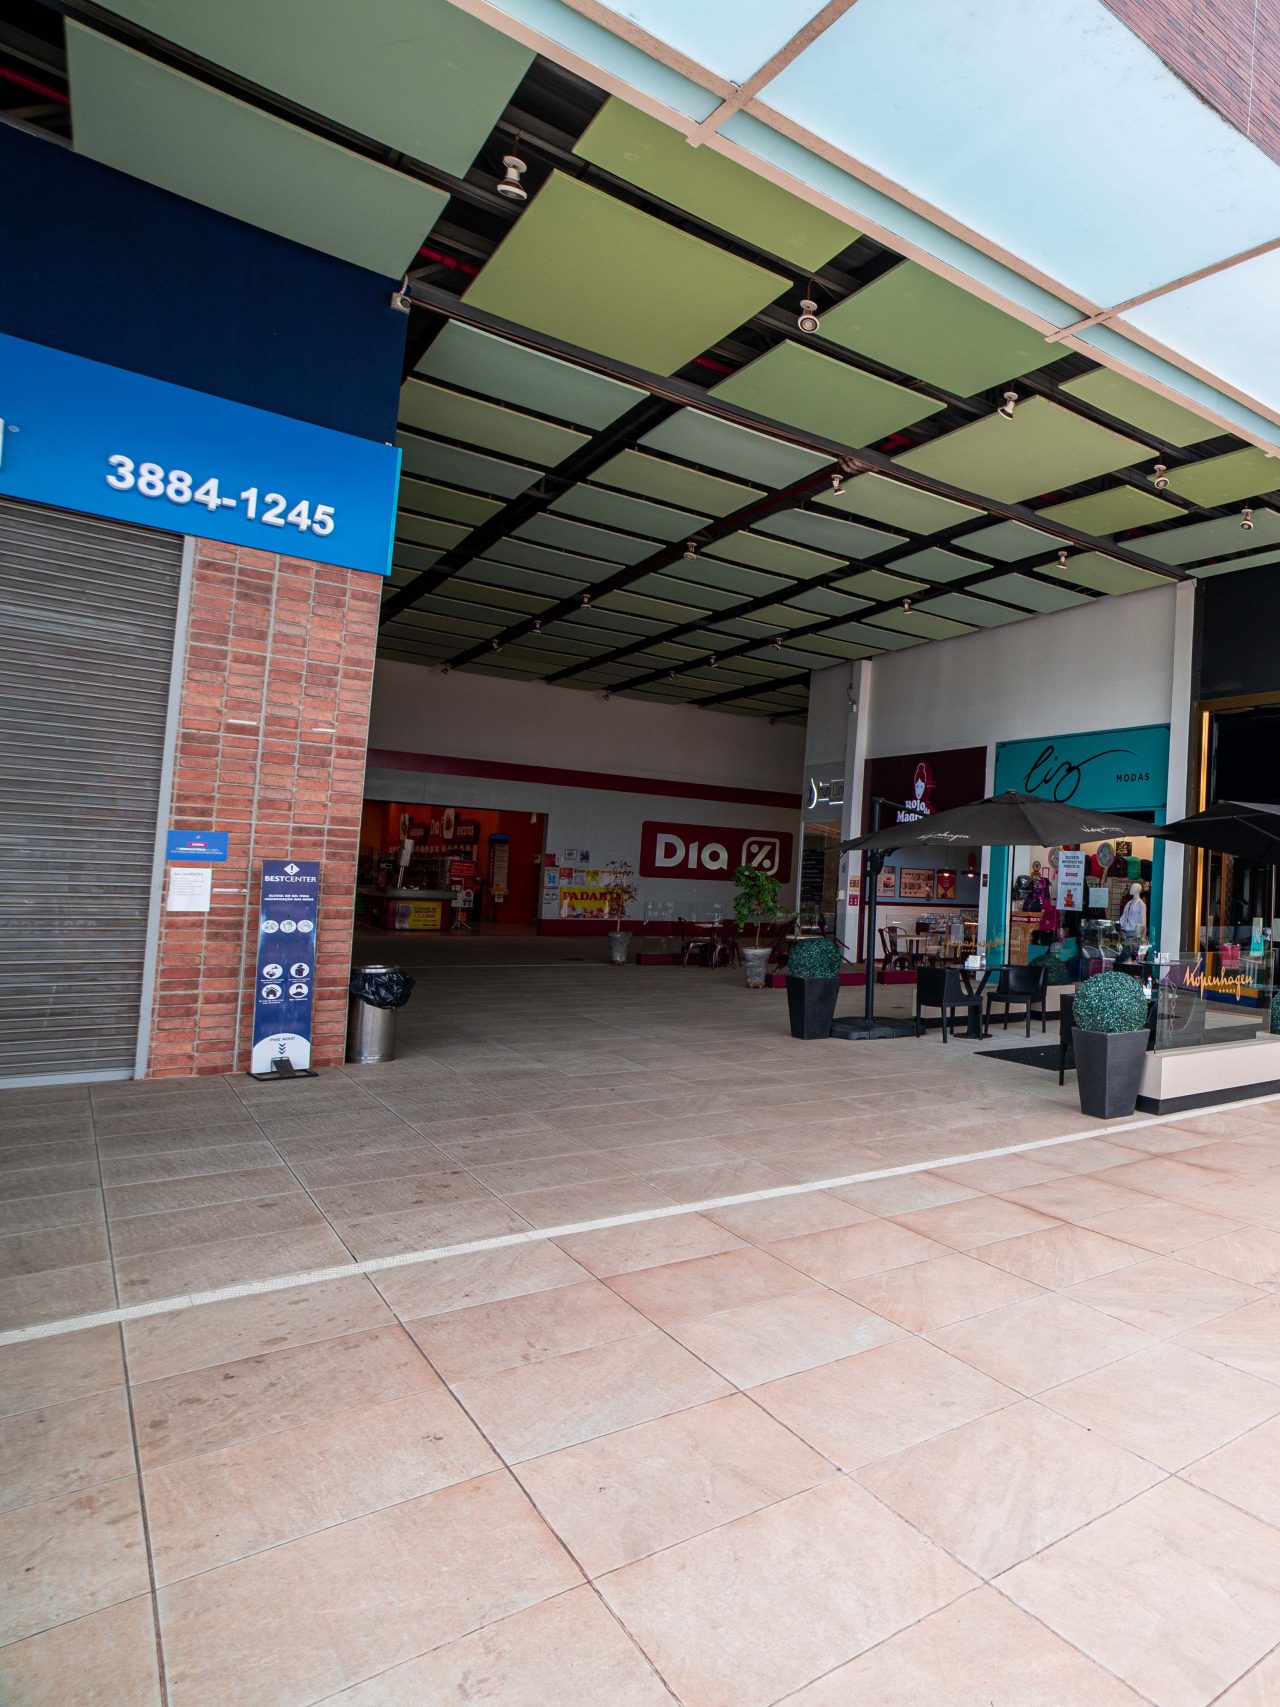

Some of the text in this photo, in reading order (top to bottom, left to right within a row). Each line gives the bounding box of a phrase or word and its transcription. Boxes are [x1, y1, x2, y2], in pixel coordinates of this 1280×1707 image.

[106, 454, 336, 536] 3884-1245
[1116, 772, 1151, 783] MODAS
[264, 875, 317, 883] BESTCENTER
[1182, 957, 1254, 1001] Kopenhagen
